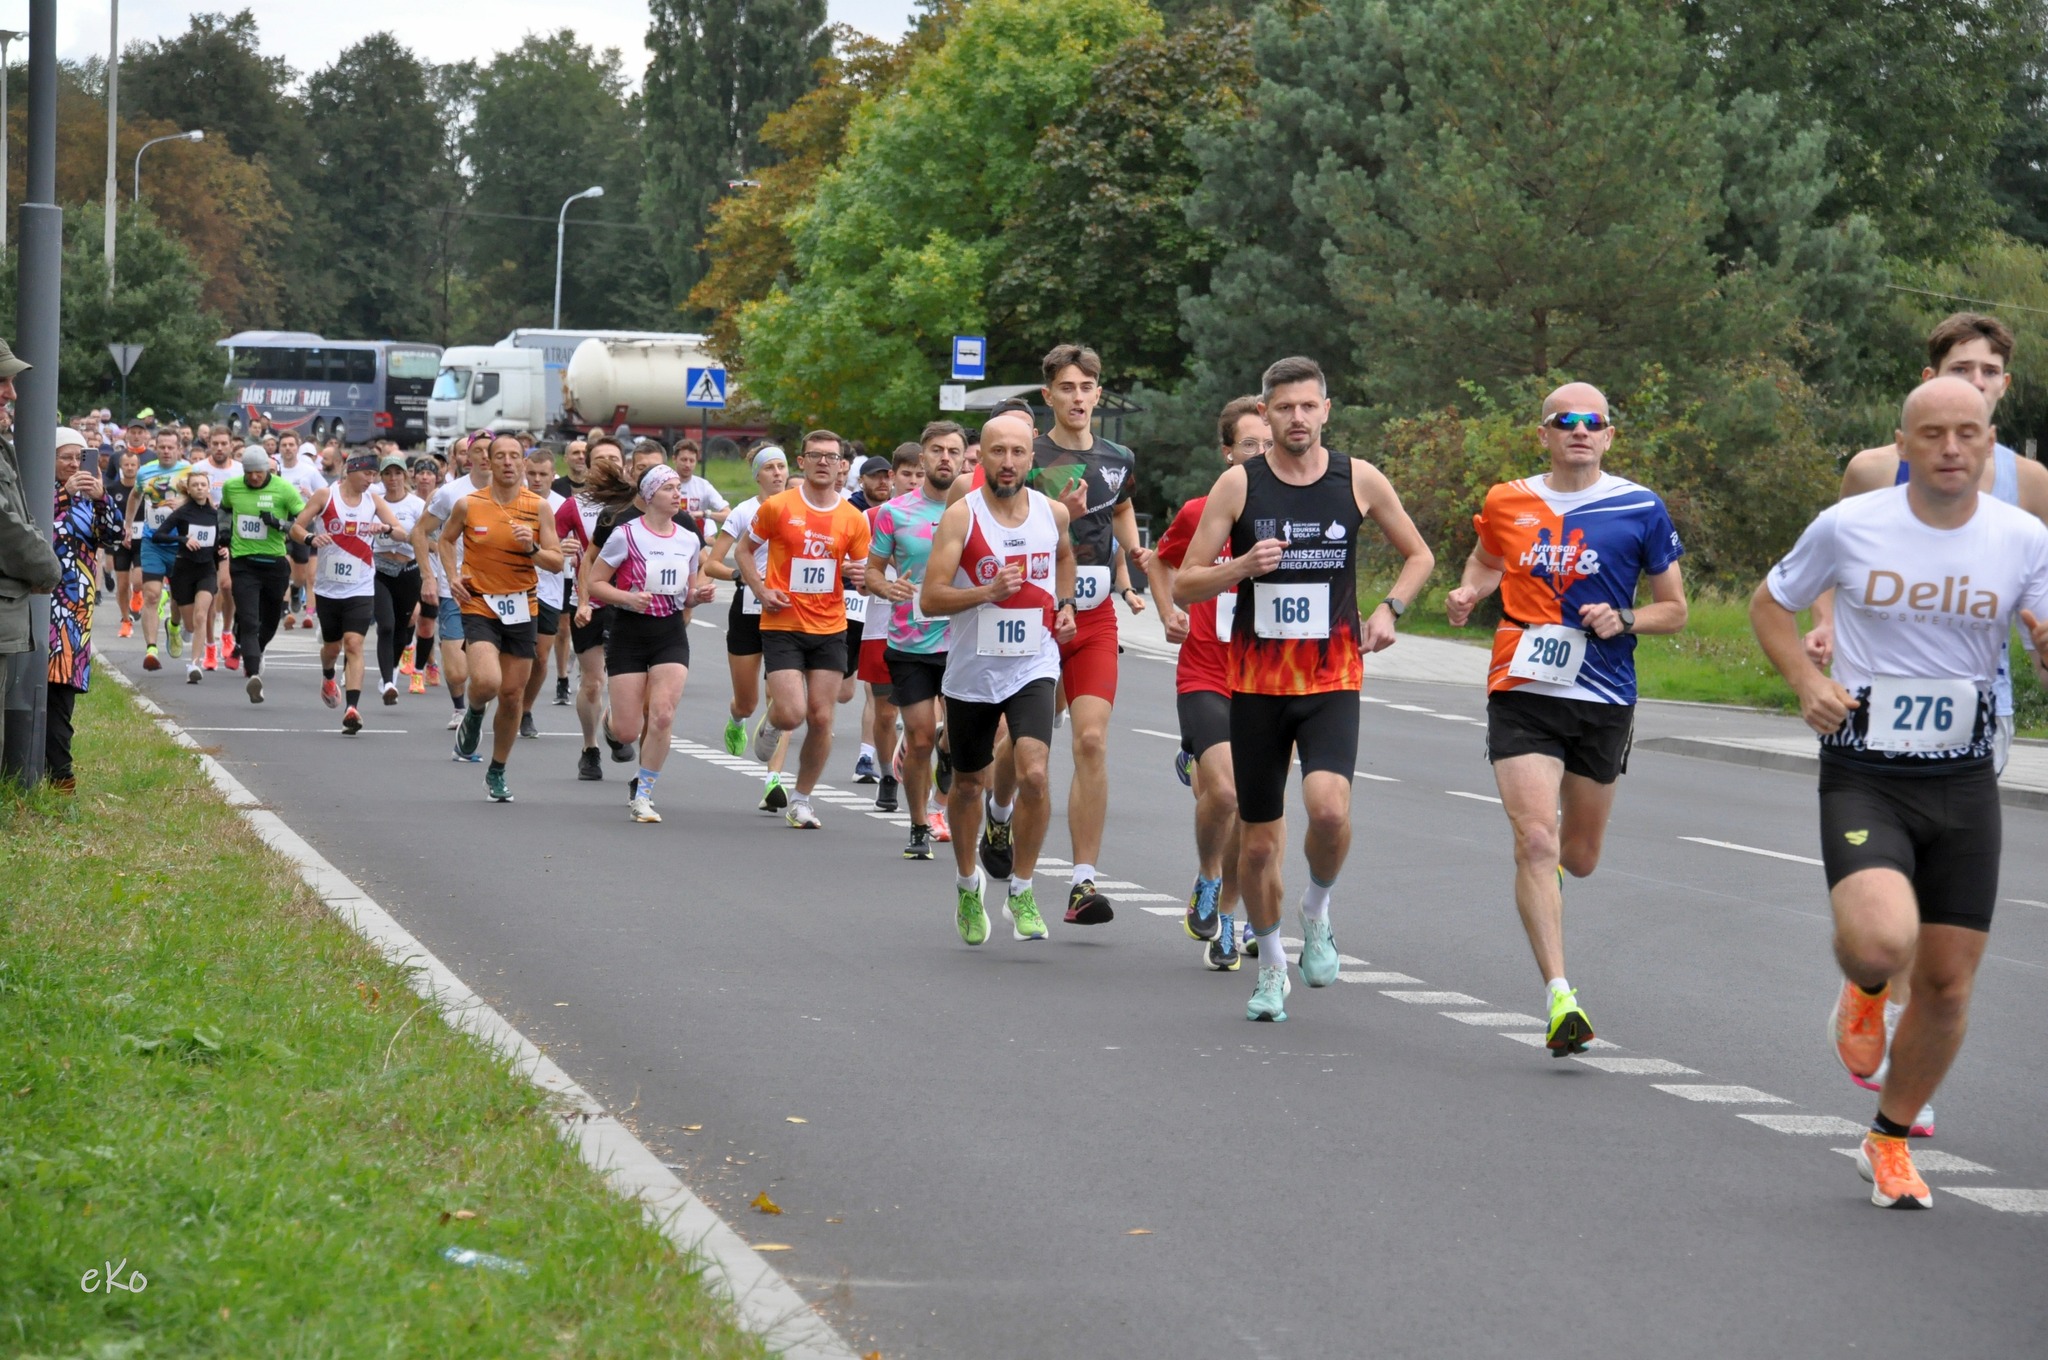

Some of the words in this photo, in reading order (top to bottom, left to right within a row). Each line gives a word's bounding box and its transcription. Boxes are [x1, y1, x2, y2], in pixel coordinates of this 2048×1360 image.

[242, 520, 261, 533] 308
[197, 531, 209, 541] 88
[1531, 543, 1577, 553] Artresan
[334, 562, 352, 577] 182
[1519, 552, 1576, 566] HALF
[1574, 549, 1601, 575] &
[1546, 565, 1574, 573] HALF
[660, 569, 677, 586] 111
[803, 567, 825, 584] 176
[1864, 570, 1998, 620] Delia
[498, 600, 515, 616] 96
[846, 597, 864, 613] 201
[1272, 597, 1310, 623] 168
[1864, 609, 1993, 632] COSMETICS
[997, 620, 1026, 643] 116
[1528, 637, 1571, 668] 280
[1892, 695, 1954, 732] 276
